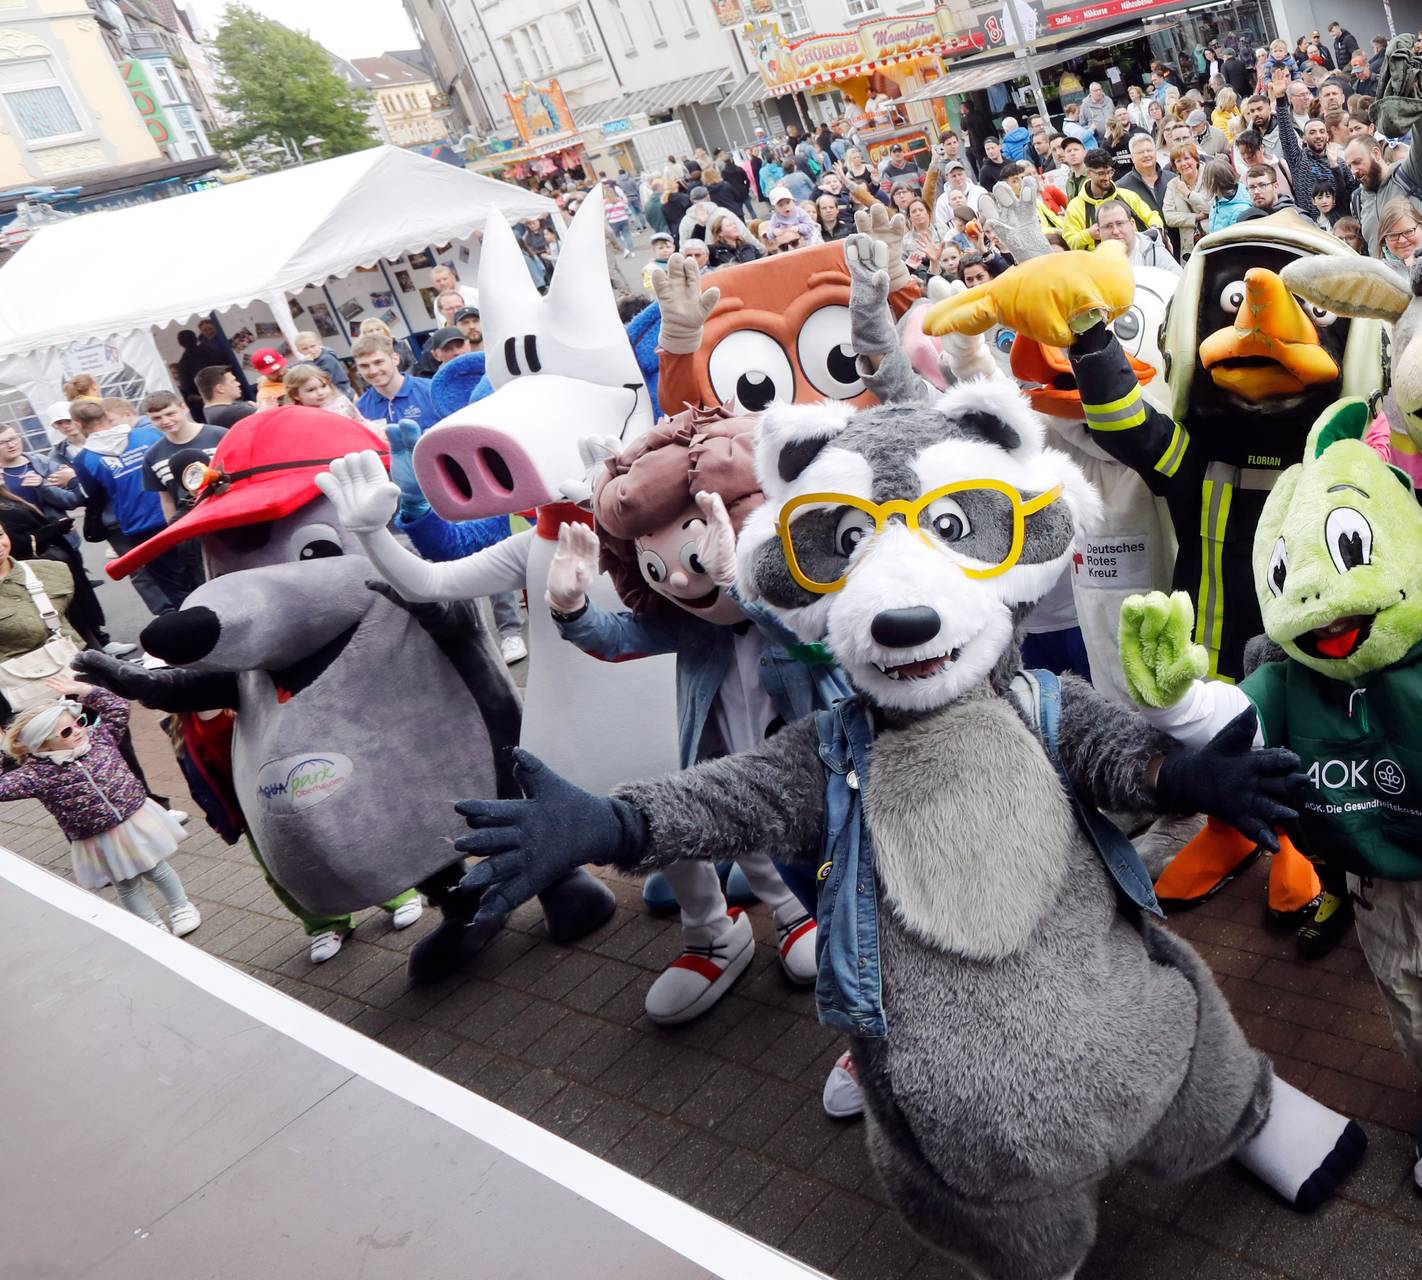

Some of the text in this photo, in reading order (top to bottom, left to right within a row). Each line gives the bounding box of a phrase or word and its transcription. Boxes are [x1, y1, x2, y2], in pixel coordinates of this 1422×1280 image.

[795, 40, 858, 66] CHURROS
[1247, 455, 1281, 466] FLORIAN
[1087, 542, 1145, 554] Deutsches
[1087, 556, 1117, 567] Rotes
[1088, 568, 1118, 578] Kreuz
[1306, 759, 1369, 790] AOK
[1326, 804, 1342, 814] Die
